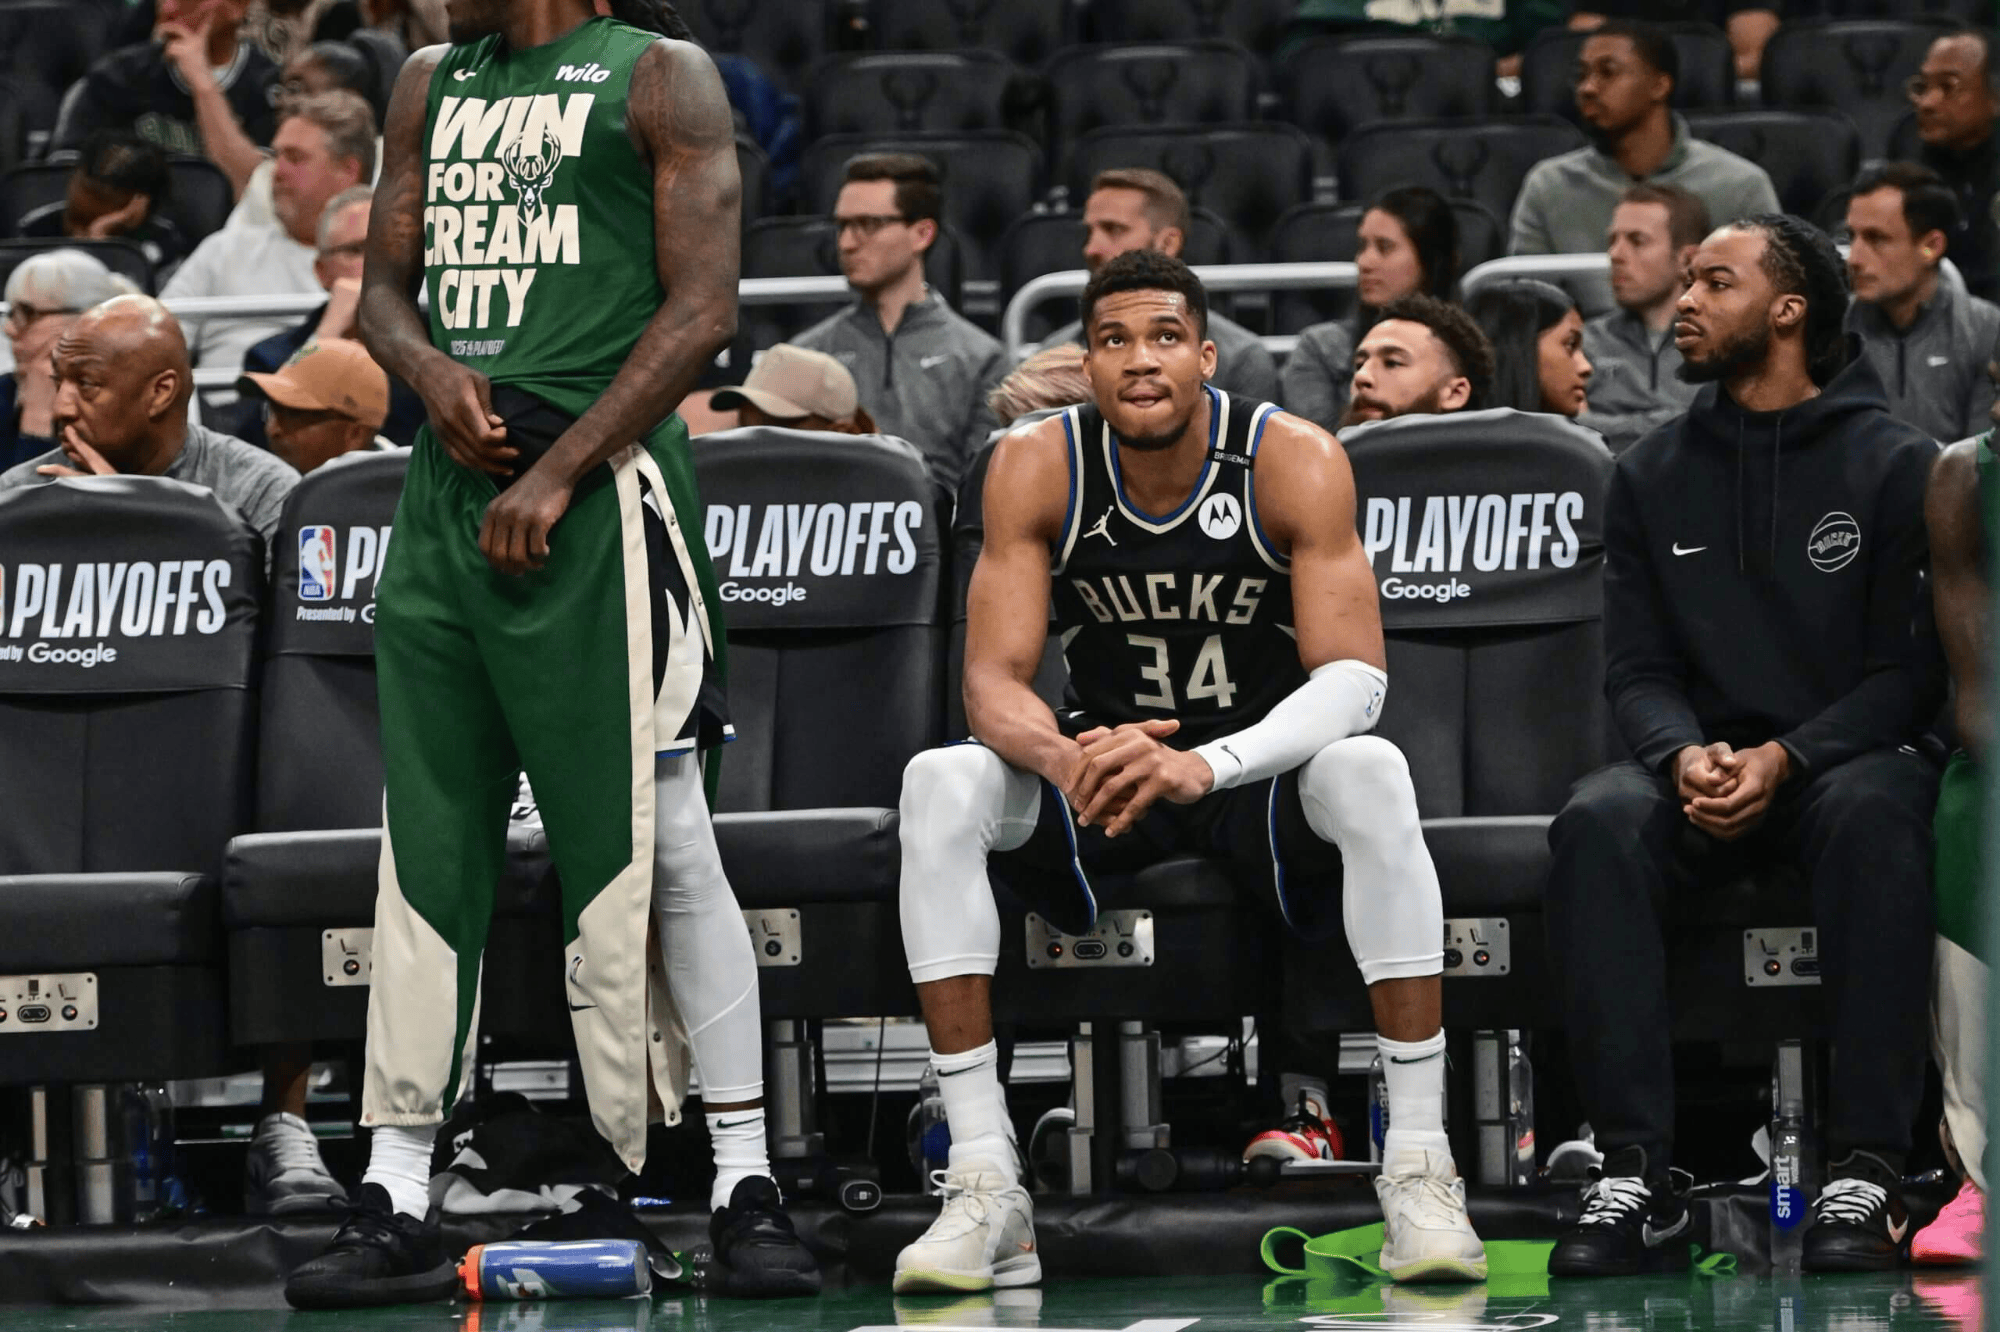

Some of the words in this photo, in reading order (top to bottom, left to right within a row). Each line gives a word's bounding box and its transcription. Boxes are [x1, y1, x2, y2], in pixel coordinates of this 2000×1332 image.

[430, 93, 596, 160] WIN
[427, 162, 505, 202] FOR
[424, 204, 580, 267] CREAM
[438, 268, 537, 330] CITY
[704, 500, 923, 577] PLAYOFFS
[1364, 491, 1584, 573] PLAYOFFS
[9, 559, 232, 638] PLAYOFFS
[296, 605, 344, 621] Presented
[343, 605, 356, 624] by
[719, 581, 807, 606] Google
[1071, 573, 1268, 625] BUCKS
[1381, 577, 1471, 603] Google
[28, 641, 117, 668] Google
[1126, 633, 1237, 710] 34
[1774, 1155, 1791, 1219] smart
